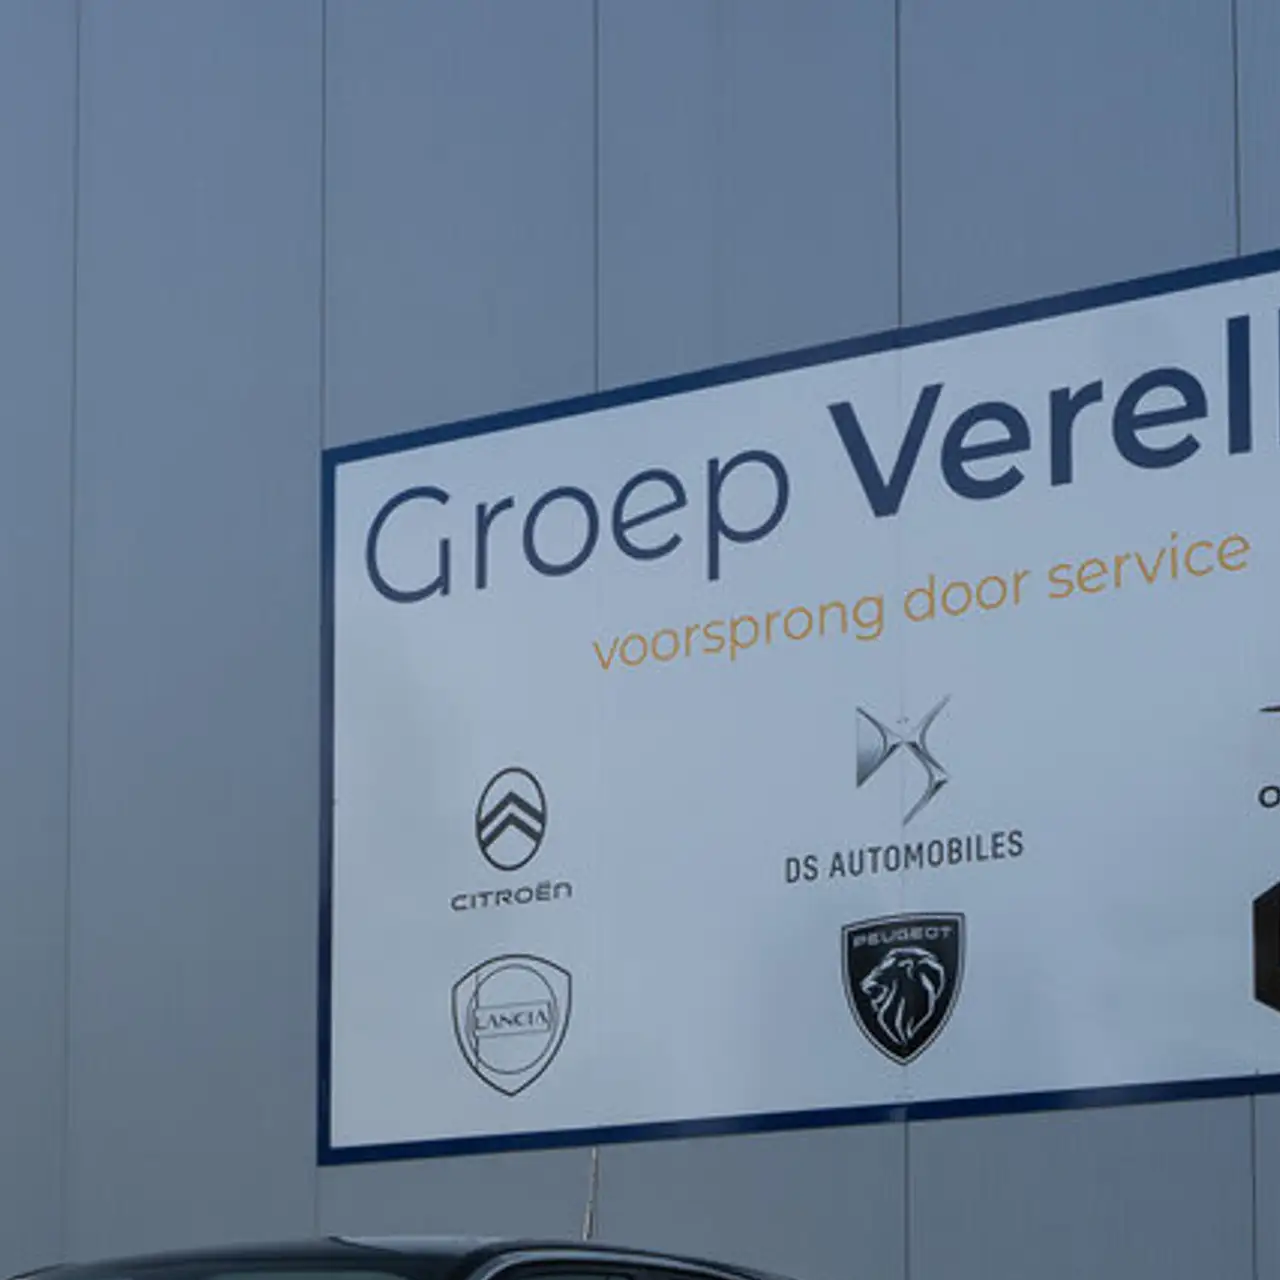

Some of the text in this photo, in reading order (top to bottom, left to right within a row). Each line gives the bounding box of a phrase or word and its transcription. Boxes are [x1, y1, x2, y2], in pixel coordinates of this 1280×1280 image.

[366, 447, 789, 603] Groep
[593, 531, 1251, 673] voorsprong door service
[785, 829, 1025, 884] DS AUTOMOBILES
[853, 923, 955, 948] PEUGEOT
[476, 1008, 549, 1031] LANCIA
